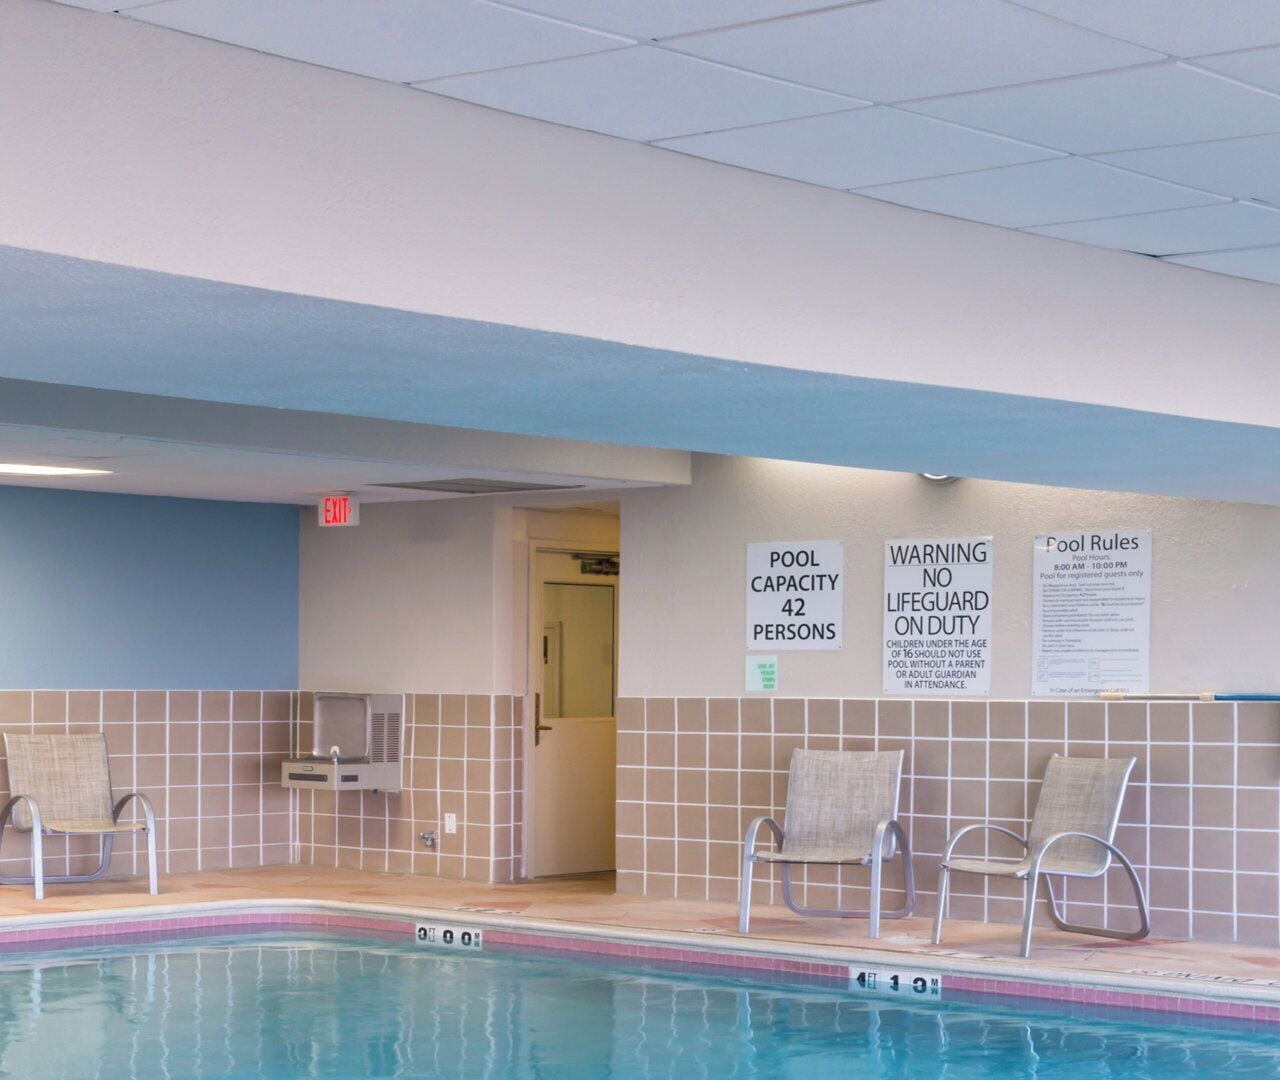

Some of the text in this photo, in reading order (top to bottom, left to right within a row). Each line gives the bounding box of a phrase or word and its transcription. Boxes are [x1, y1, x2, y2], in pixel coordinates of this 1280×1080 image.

[324, 497, 348, 524] EXIT
[1046, 533, 1139, 552] Pool Rules
[770, 550, 820, 568] POOL
[890, 542, 987, 564] WARNING
[751, 574, 839, 592] CAPACITY
[923, 568, 952, 587] NO
[1040, 572, 1056, 580] Pool
[1068, 570, 1102, 580] registered
[1104, 571, 1126, 579] guests
[1128, 570, 1144, 578] only
[781, 598, 806, 616] 42
[887, 591, 989, 612] LIFEGUARD
[754, 623, 836, 640] PERSONS
[894, 615, 980, 635] ON DUTY
[886, 639, 988, 648] CHILDREN UNDER THE AGE
[892, 649, 982, 658] OF 16 SHOULD NOT USE
[888, 660, 986, 668] POOL WITHOUT A PARENT
[896, 670, 976, 678] OR ADULT GUARDIAN
[904, 680, 968, 689] IN ATTENDANCE.
